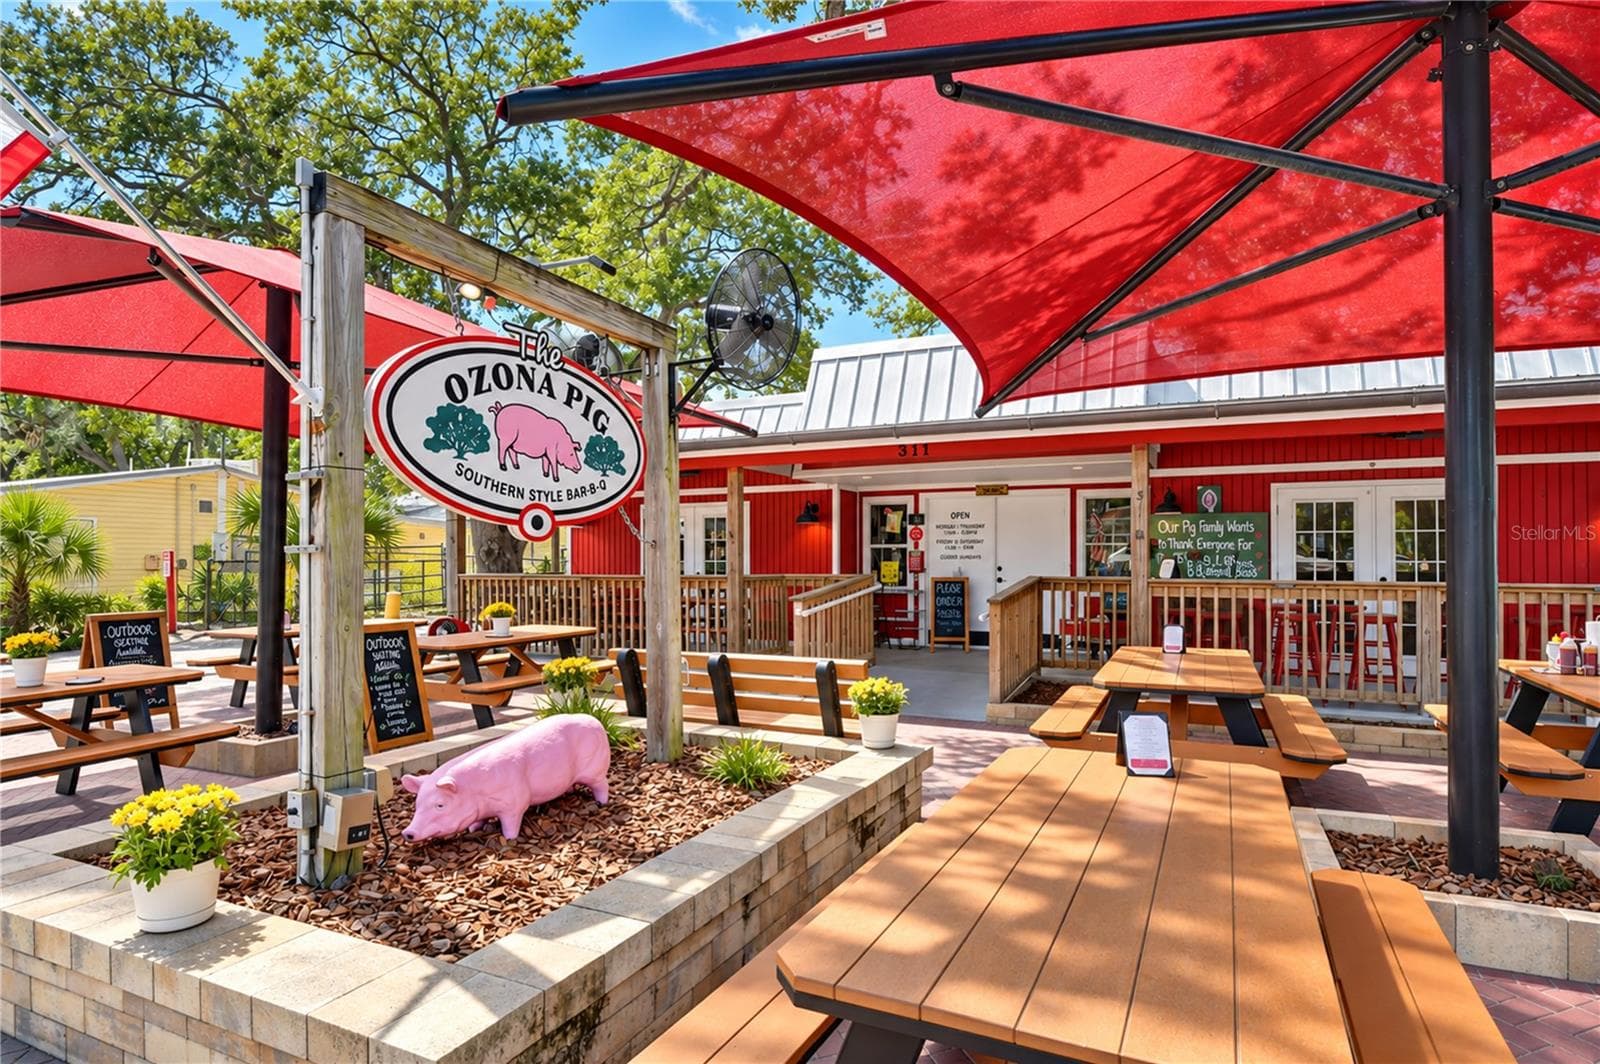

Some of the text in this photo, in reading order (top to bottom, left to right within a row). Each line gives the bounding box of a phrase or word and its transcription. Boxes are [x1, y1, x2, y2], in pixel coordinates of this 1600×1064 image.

[502, 320, 565, 371] The
[445, 362, 611, 436] OZONA PIG
[898, 442, 929, 457] 311
[455, 462, 608, 503] SOUTHERN STYLE BAR-B-Q
[950, 511, 970, 519] OPEN
[1158, 519, 1180, 534] Our
[1182, 519, 1197, 537] Pig
[1227, 519, 1255, 533] Wants
[1167, 537, 1194, 549] Thank
[1196, 537, 1235, 553] Everyone
[1237, 538, 1254, 550] For
[106, 623, 157, 638] OUTDOOR
[366, 636, 406, 651] OUTDOOR
